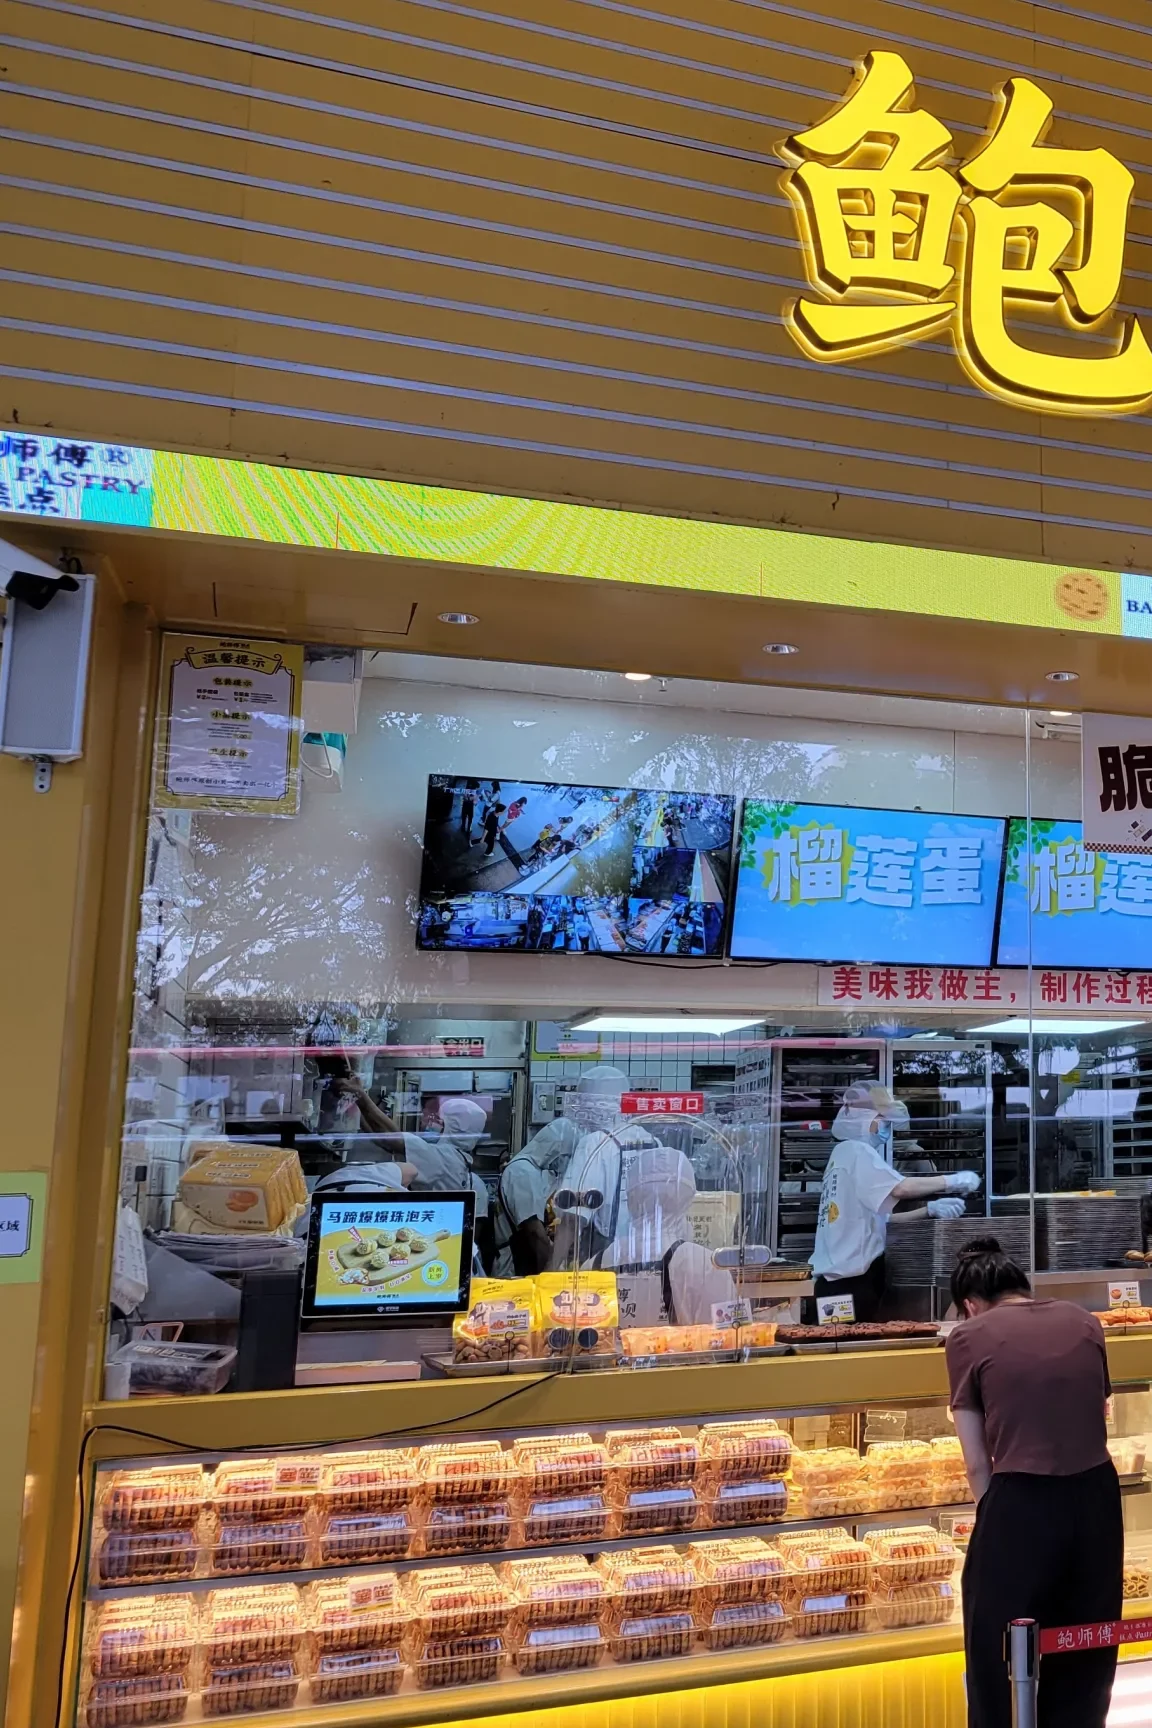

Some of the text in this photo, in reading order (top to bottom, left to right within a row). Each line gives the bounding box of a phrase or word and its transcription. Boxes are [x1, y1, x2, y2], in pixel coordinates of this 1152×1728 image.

[17, 467, 145, 495] PASTRY
[202, 652, 266, 668] 温馨提示
[768, 827, 983, 908] 榴莲蛋
[635, 1097, 699, 1112] 售卖窗口
[327, 1210, 436, 1224] 马蹄爆爆珠泡芙
